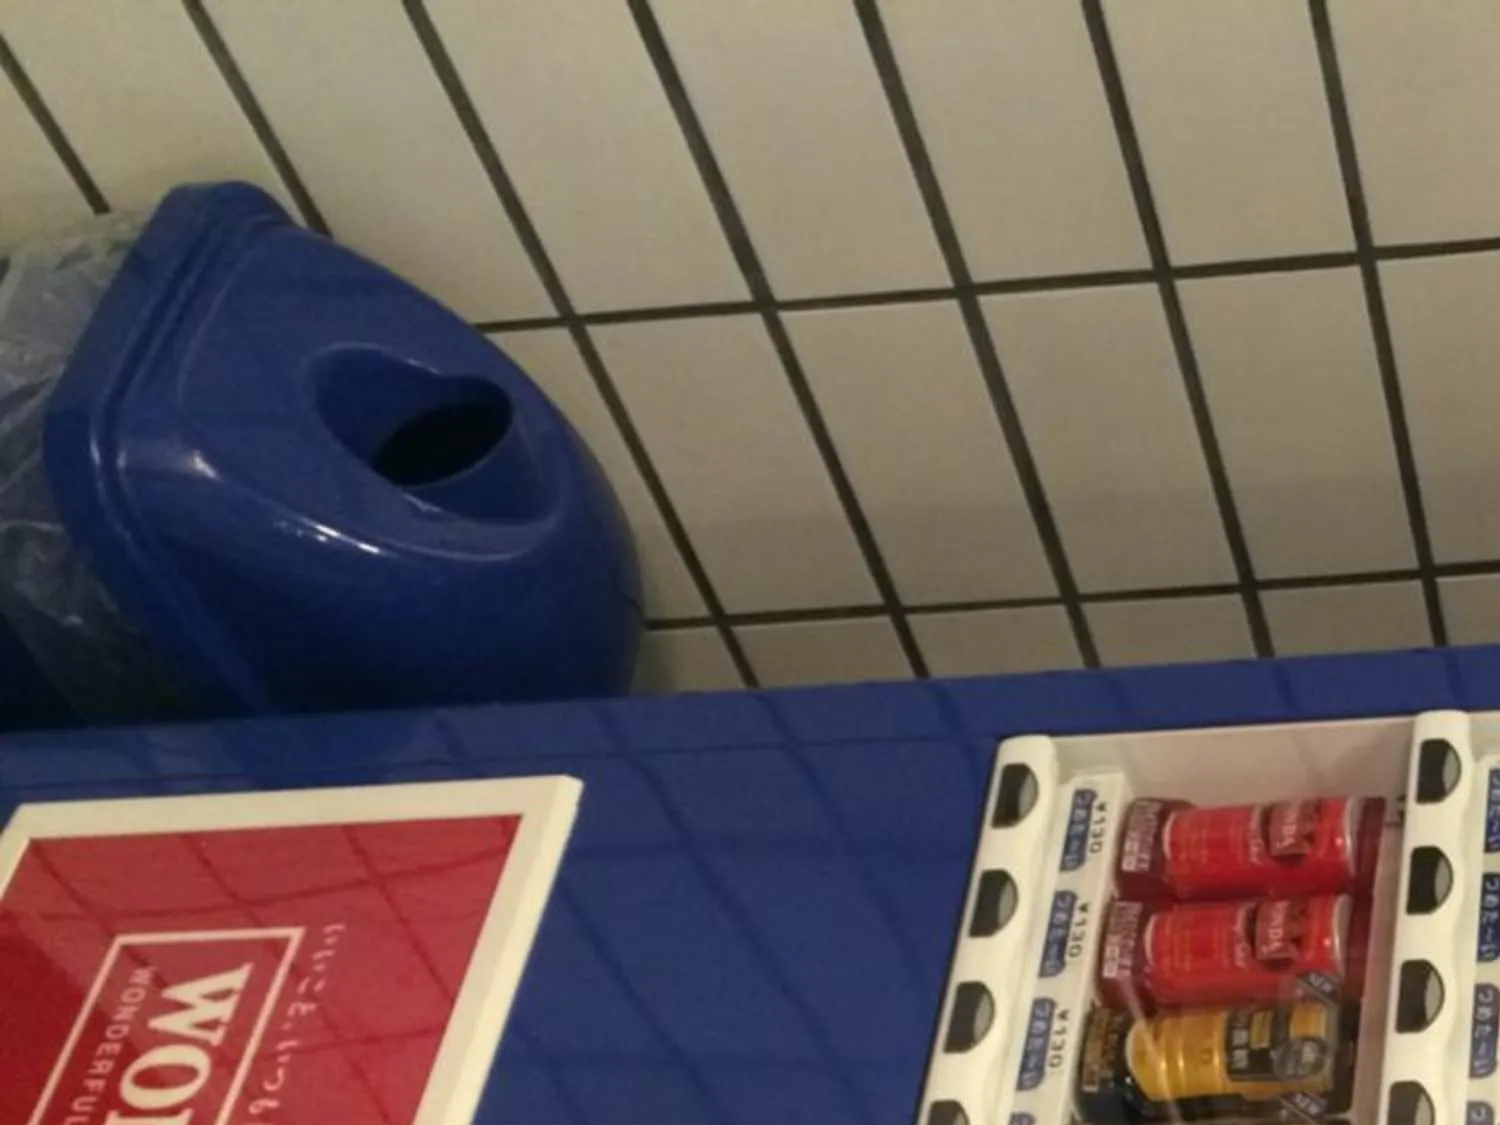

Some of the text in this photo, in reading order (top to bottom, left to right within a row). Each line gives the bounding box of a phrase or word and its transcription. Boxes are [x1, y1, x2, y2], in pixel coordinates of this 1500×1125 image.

[1089, 801, 1107, 854] ¥130
[1068, 902, 1089, 958] ¥130
[1049, 1008, 1070, 1069] ¥130
